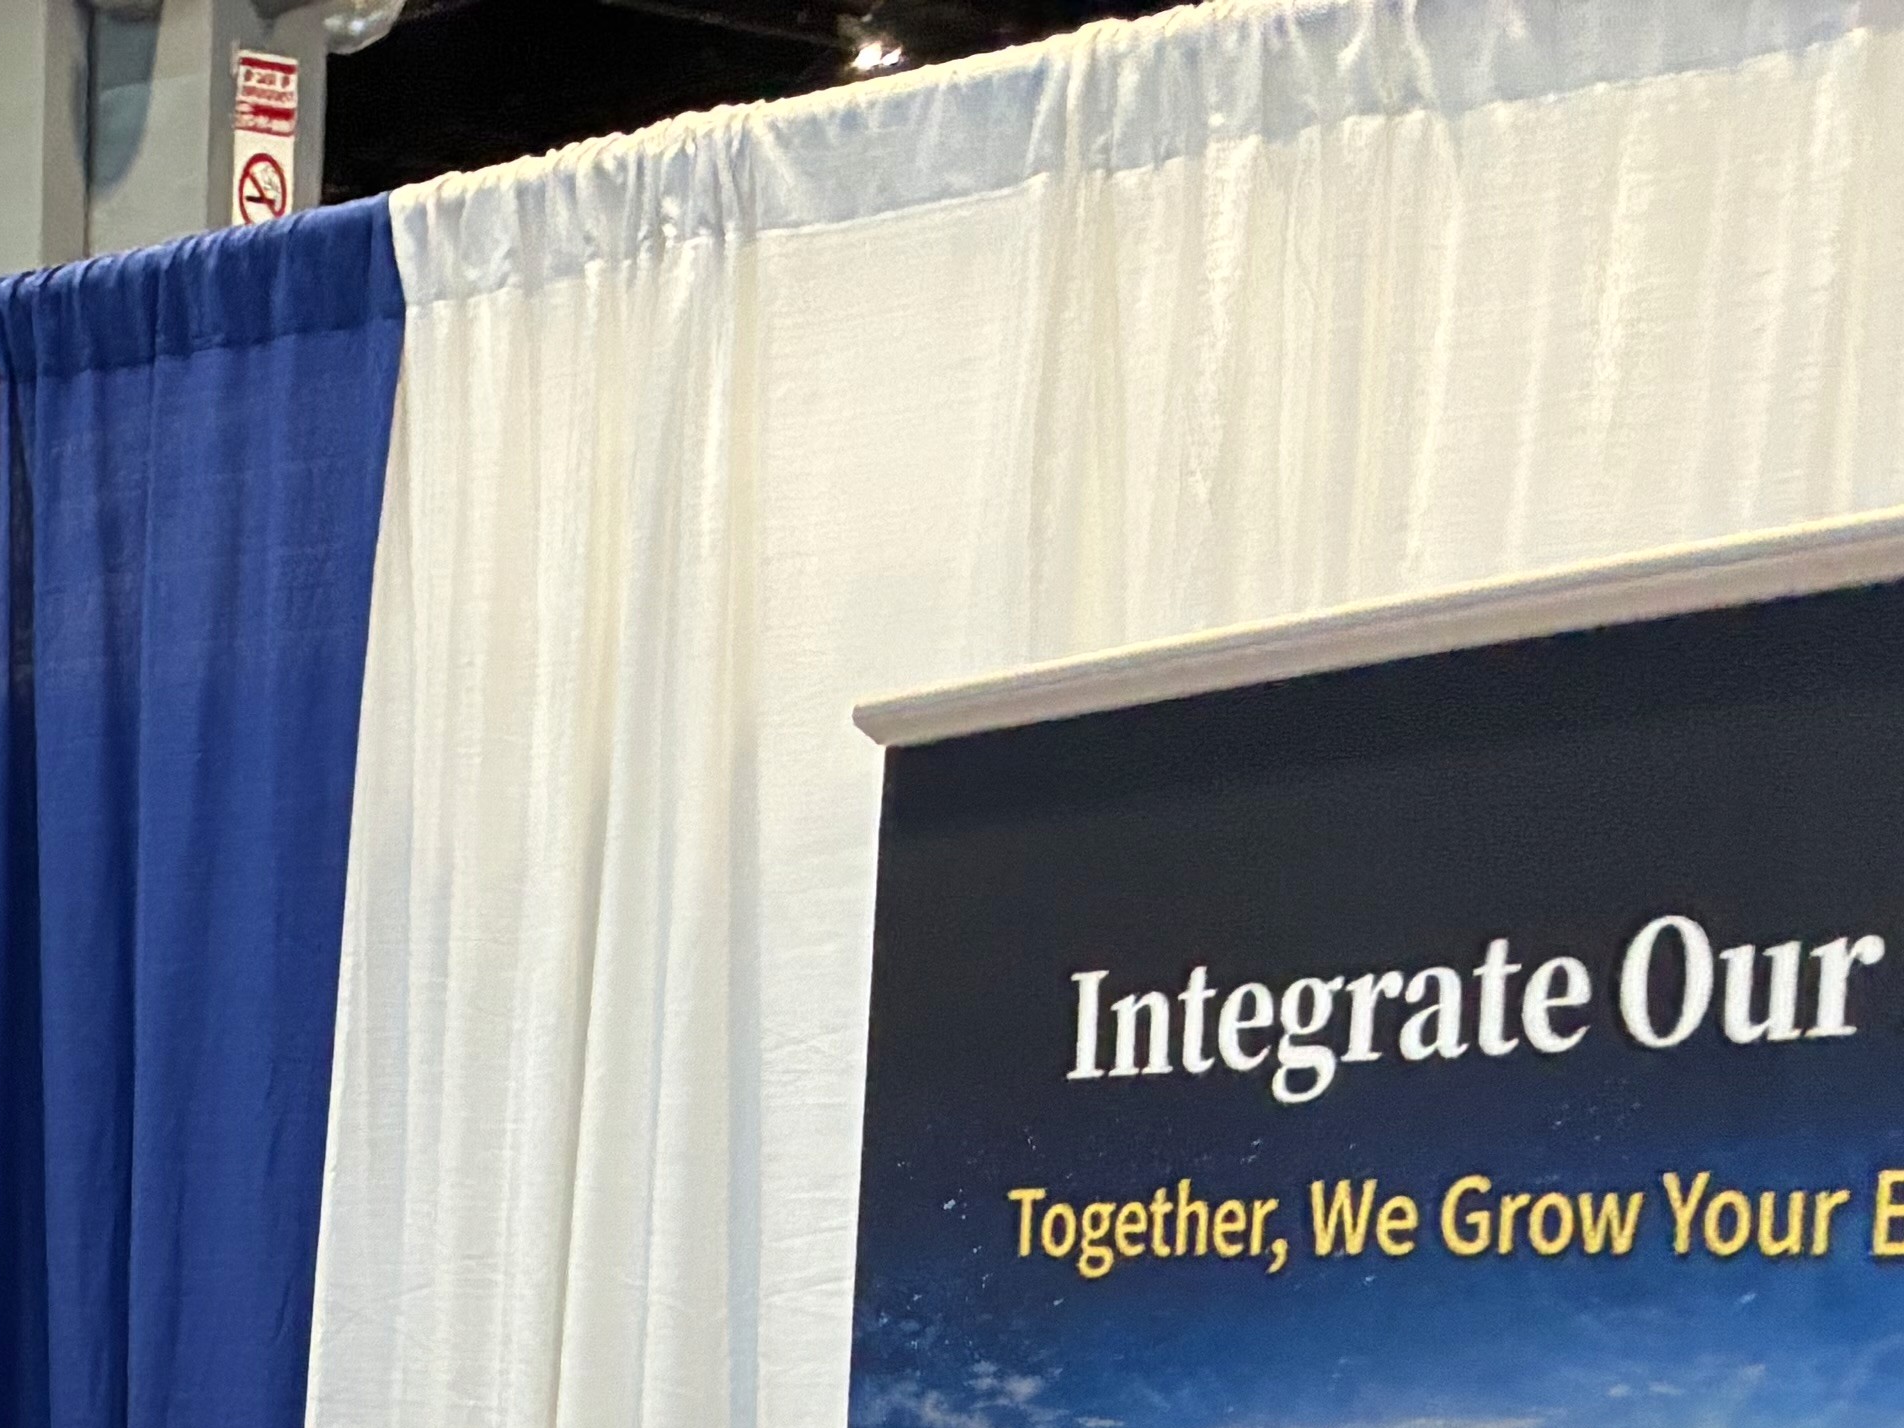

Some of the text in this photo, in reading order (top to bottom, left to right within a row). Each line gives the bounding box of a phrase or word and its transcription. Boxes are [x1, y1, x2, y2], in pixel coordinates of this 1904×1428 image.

[1066, 914, 1885, 1105] Integrate Our
[1008, 1169, 1851, 1279] Together, We Grow Your
